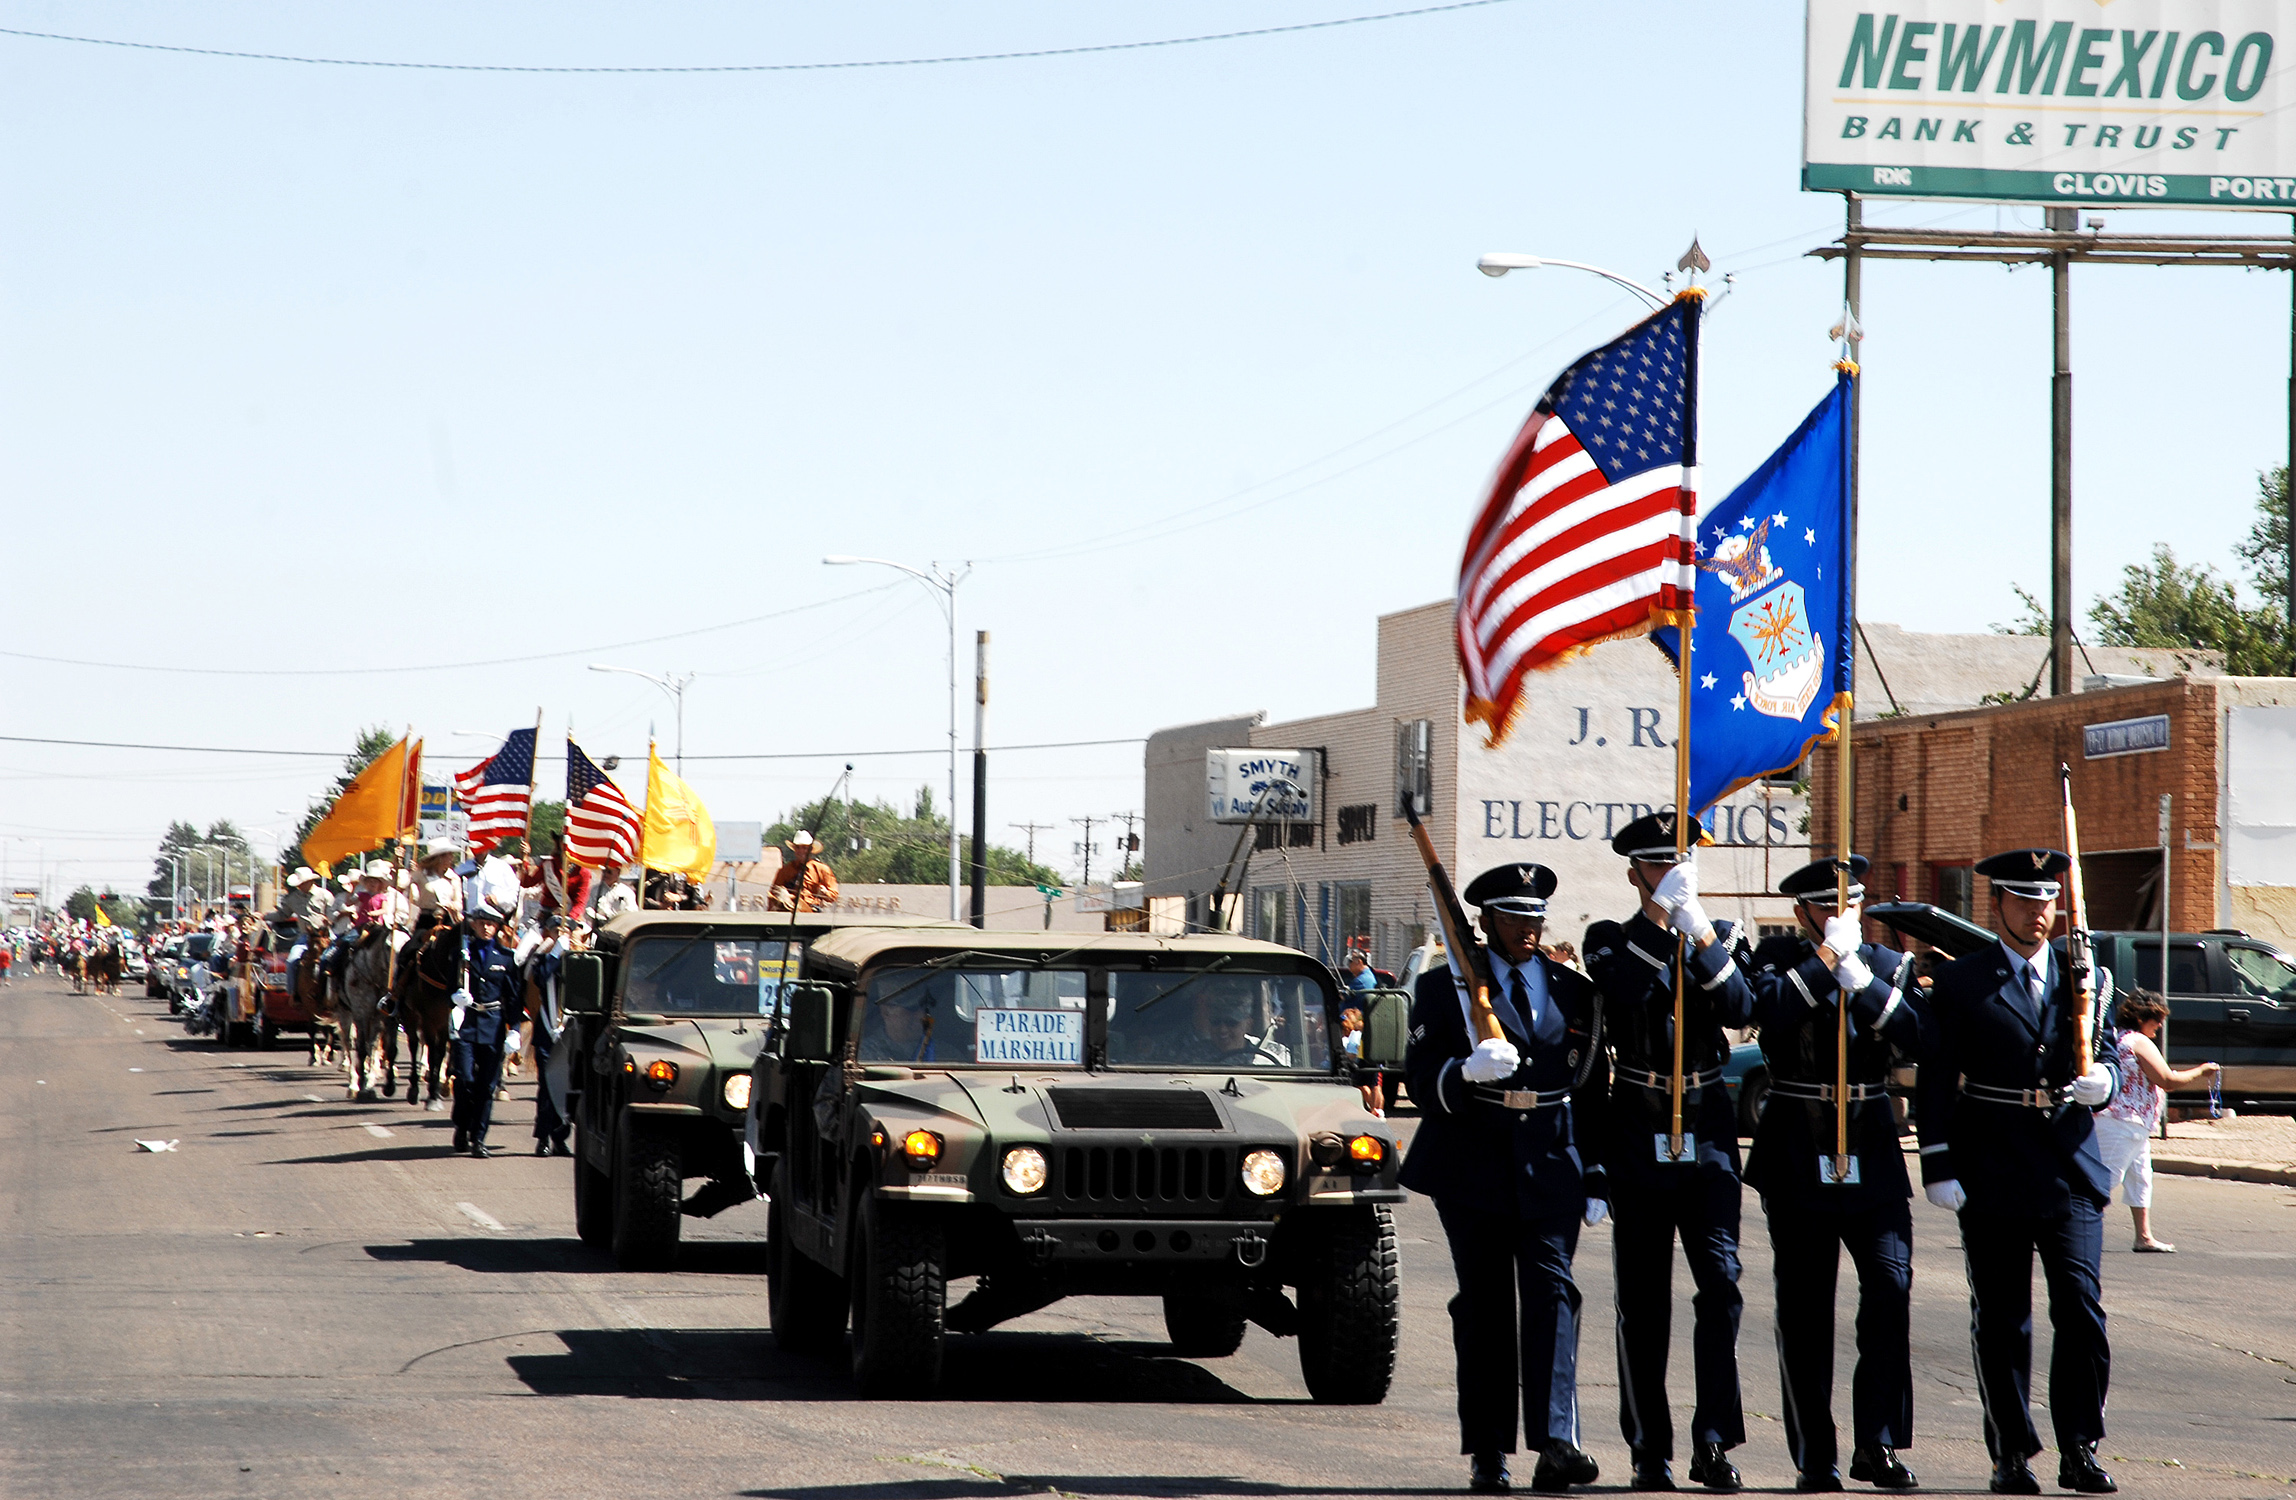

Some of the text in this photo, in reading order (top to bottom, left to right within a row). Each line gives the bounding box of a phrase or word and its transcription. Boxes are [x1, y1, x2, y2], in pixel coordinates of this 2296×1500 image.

[1840, 115, 2239, 151] BANK & TRUST
[1873, 166, 2296, 199] FDIC CLOVIS PORT
[1568, 705, 1607, 748] J.
[1239, 759, 1301, 779] SMYTH
[1481, 799, 1787, 846] ELECTICS
[995, 1012, 1066, 1034] PARADE
[980, 1039, 1079, 1062] MARSHALL
